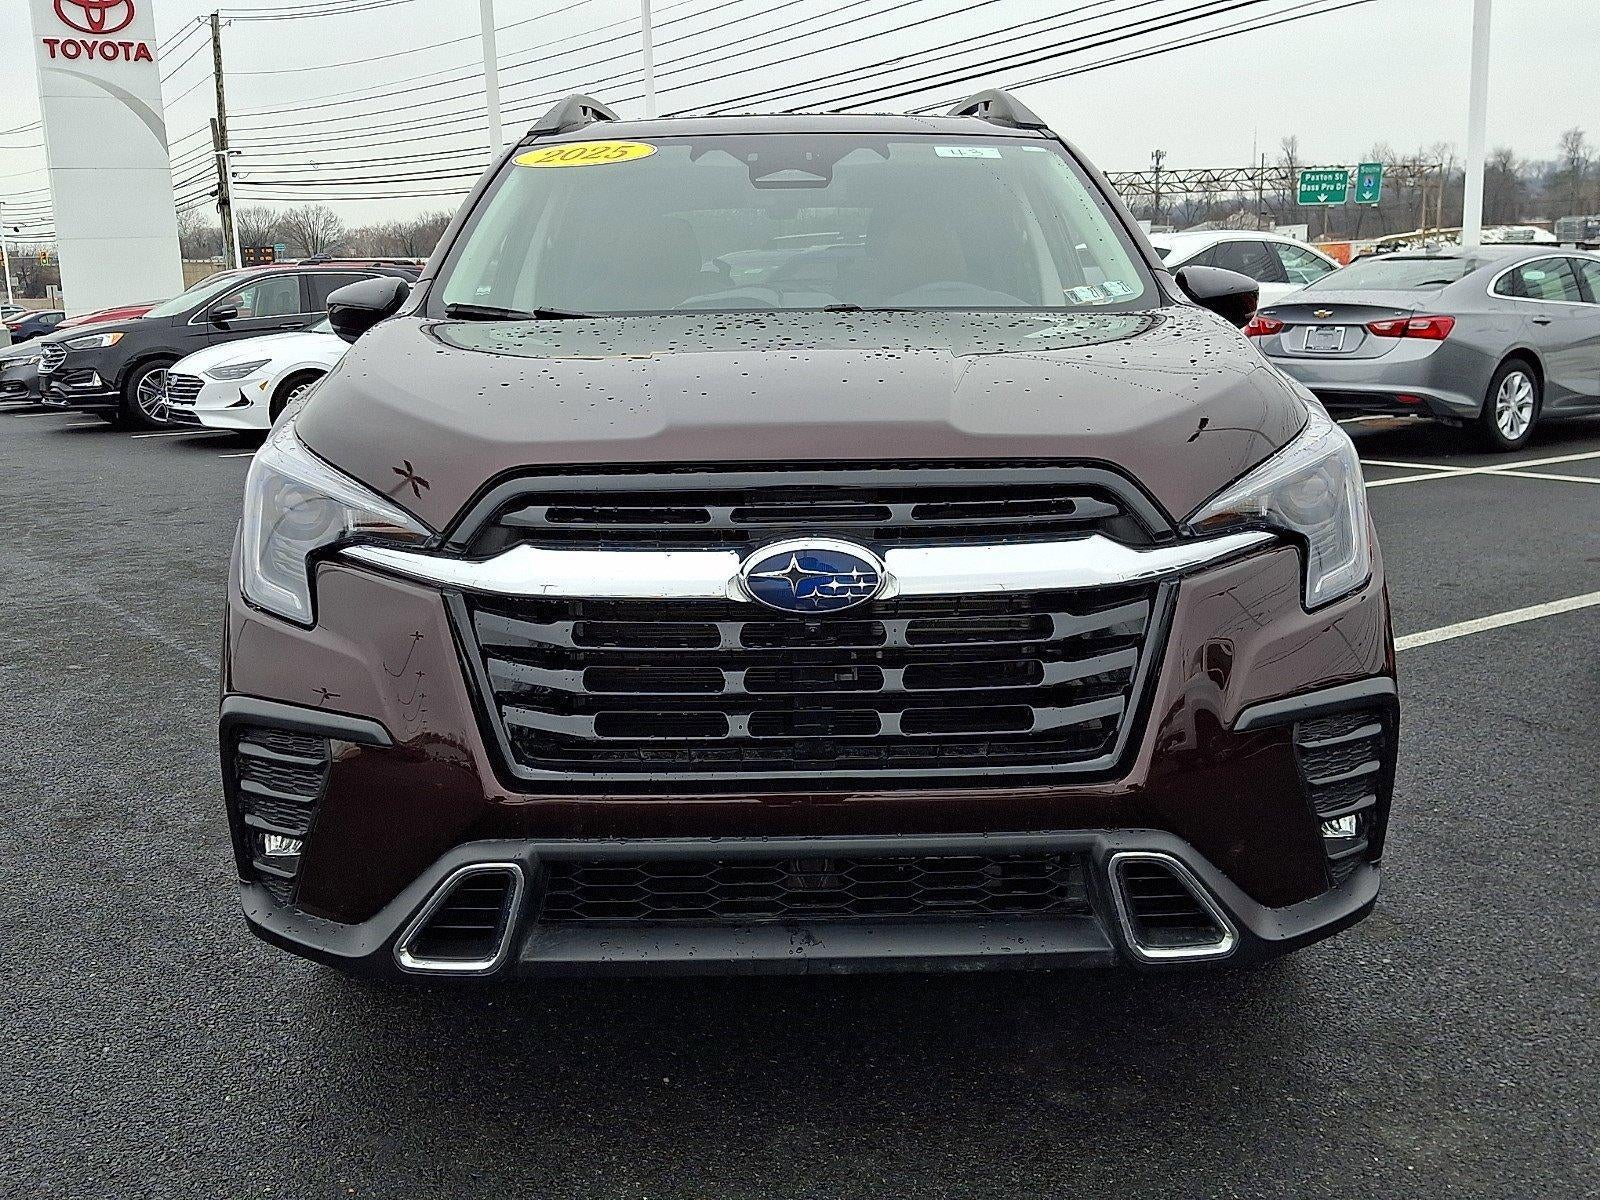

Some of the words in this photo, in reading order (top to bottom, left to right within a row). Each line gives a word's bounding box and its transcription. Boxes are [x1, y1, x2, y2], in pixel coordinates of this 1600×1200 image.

[43, 38, 153, 62] TOYOTA
[534, 145, 635, 163] 2025
[1305, 172, 1333, 181] Paxton
[1334, 172, 1343, 181] St
[1321, 183, 1334, 191] Pro
